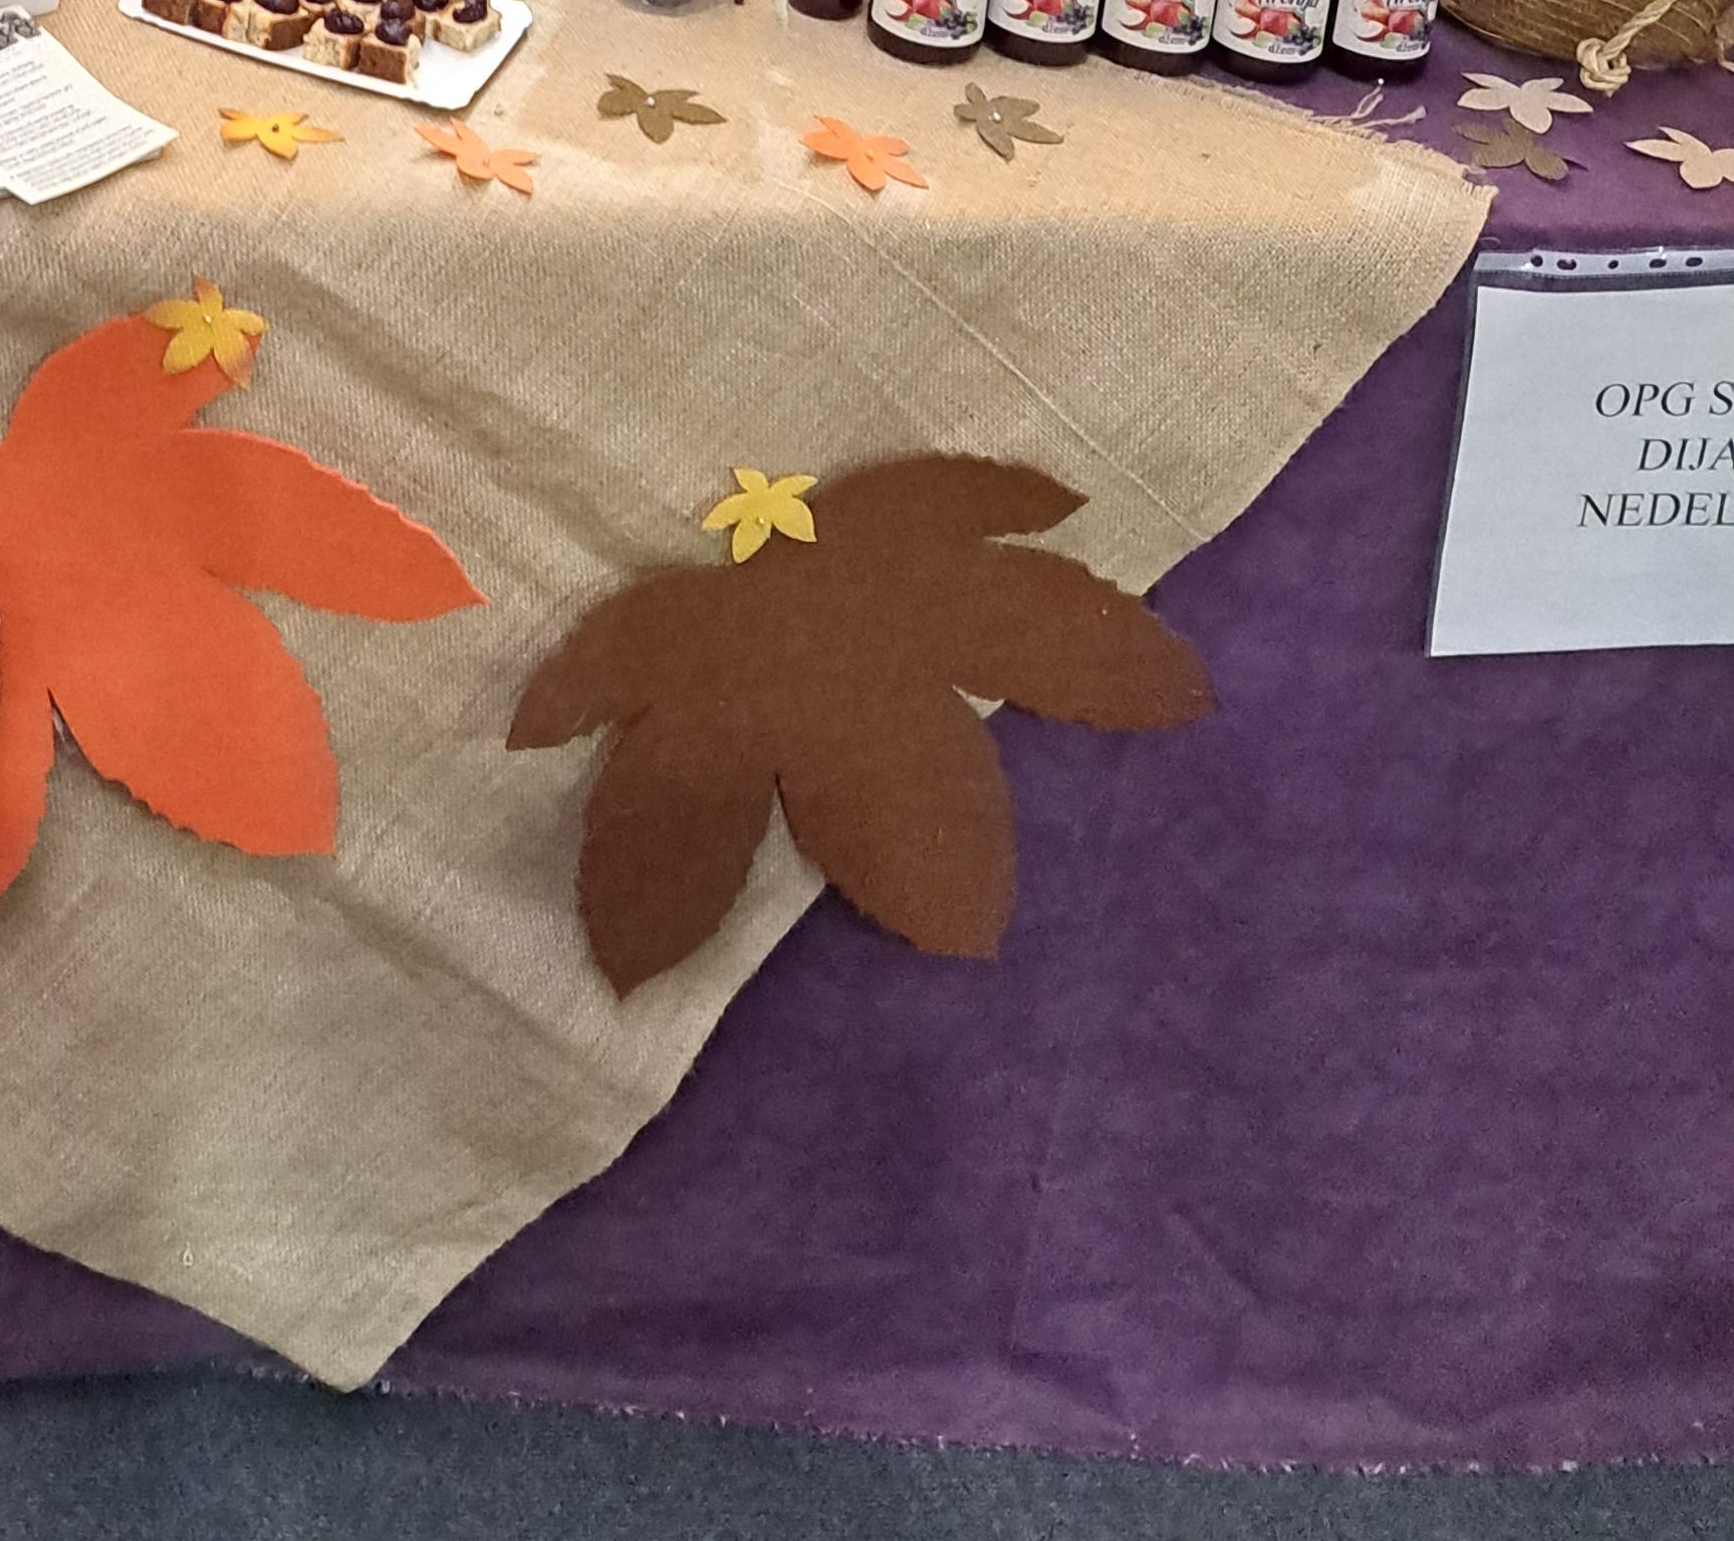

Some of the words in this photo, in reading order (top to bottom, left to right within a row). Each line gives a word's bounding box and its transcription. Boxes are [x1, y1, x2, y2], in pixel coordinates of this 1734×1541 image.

[1595, 381, 1696, 418] OPG
[1709, 380, 1734, 416] S
[1637, 437, 1734, 471] DIJA
[1577, 491, 1734, 527] NEDEL
